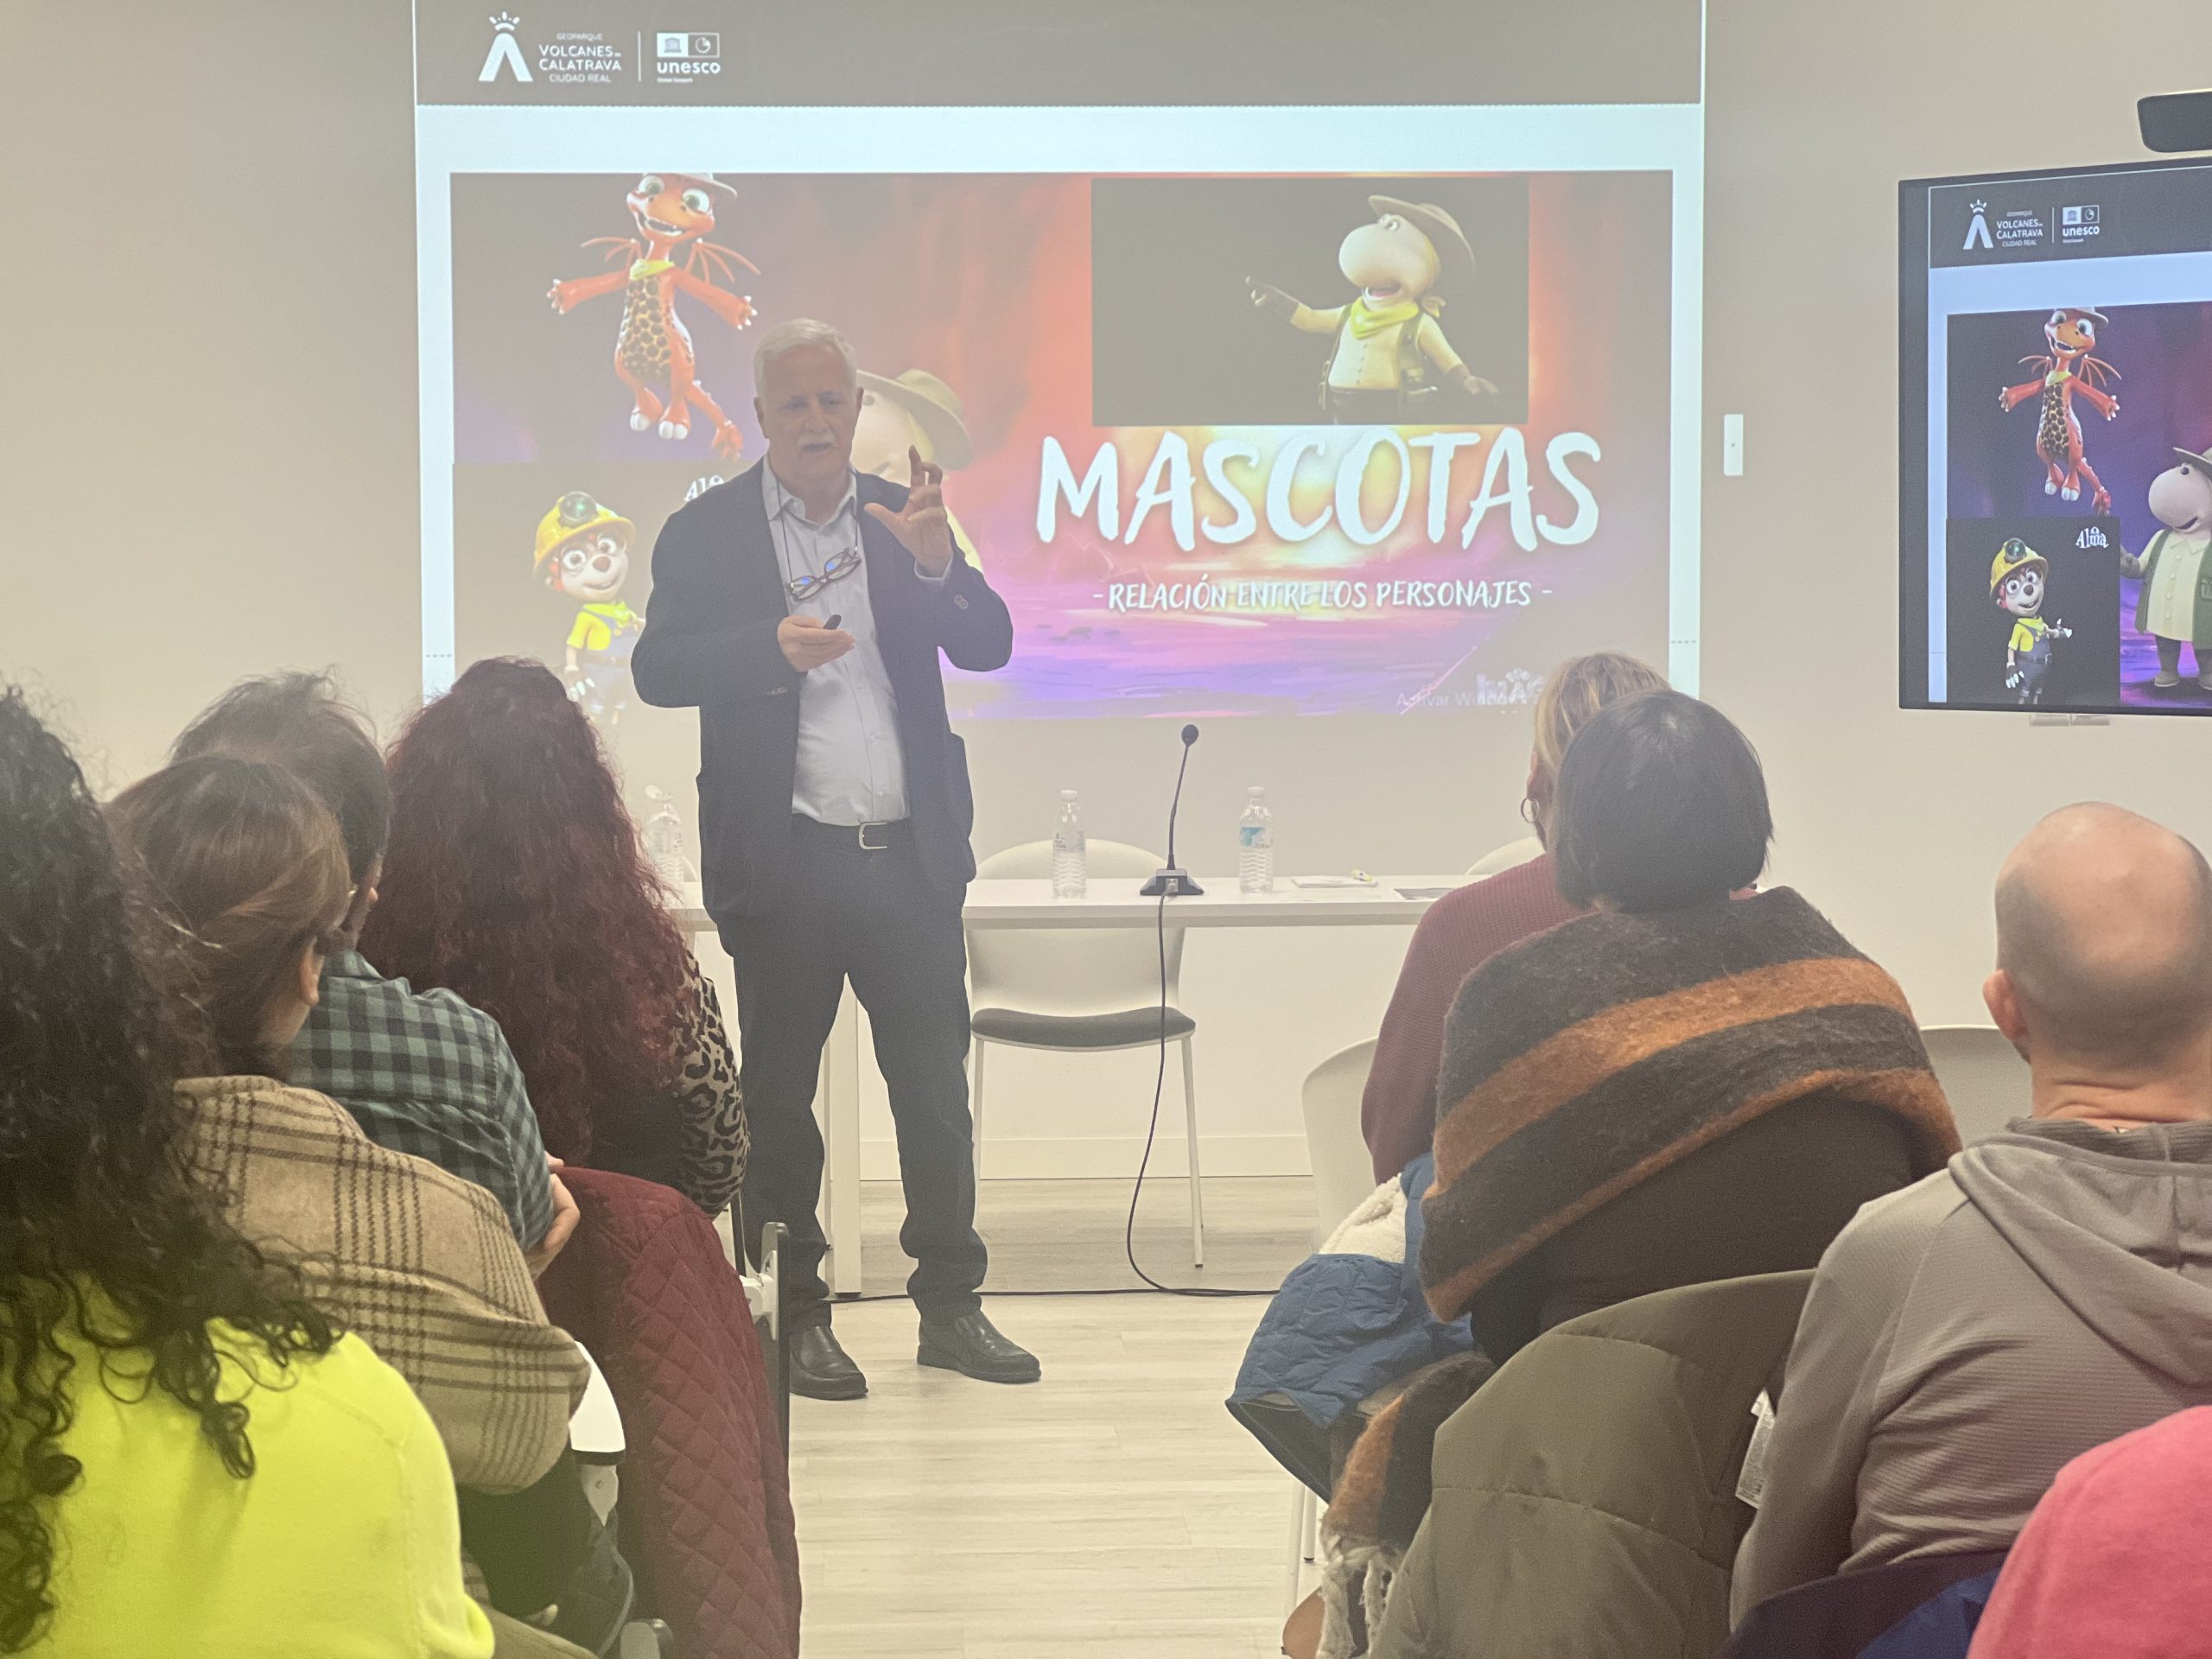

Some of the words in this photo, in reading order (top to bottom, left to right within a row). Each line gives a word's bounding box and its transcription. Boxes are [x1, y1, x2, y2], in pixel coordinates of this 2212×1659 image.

[556, 32, 603, 42] GEOPARQUE
[539, 45, 613, 57] VOLCANES
[539, 59, 621, 71] CALATRAVA
[657, 61, 721, 74] unesco
[549, 73, 585, 83] CIUDAD
[588, 73, 612, 82] REAL
[1997, 219, 2039, 229] VOLCANES
[1997, 229, 2043, 239] CALATRAVA
[2063, 226, 2100, 237] unesco
[1036, 427, 1602, 552] MASCOTAS
[2075, 526, 2109, 549] Alma
[1237, 581, 1314, 611] ENTRE
[1320, 580, 1367, 609] LOS
[1376, 579, 1532, 608] PERSONAJES
